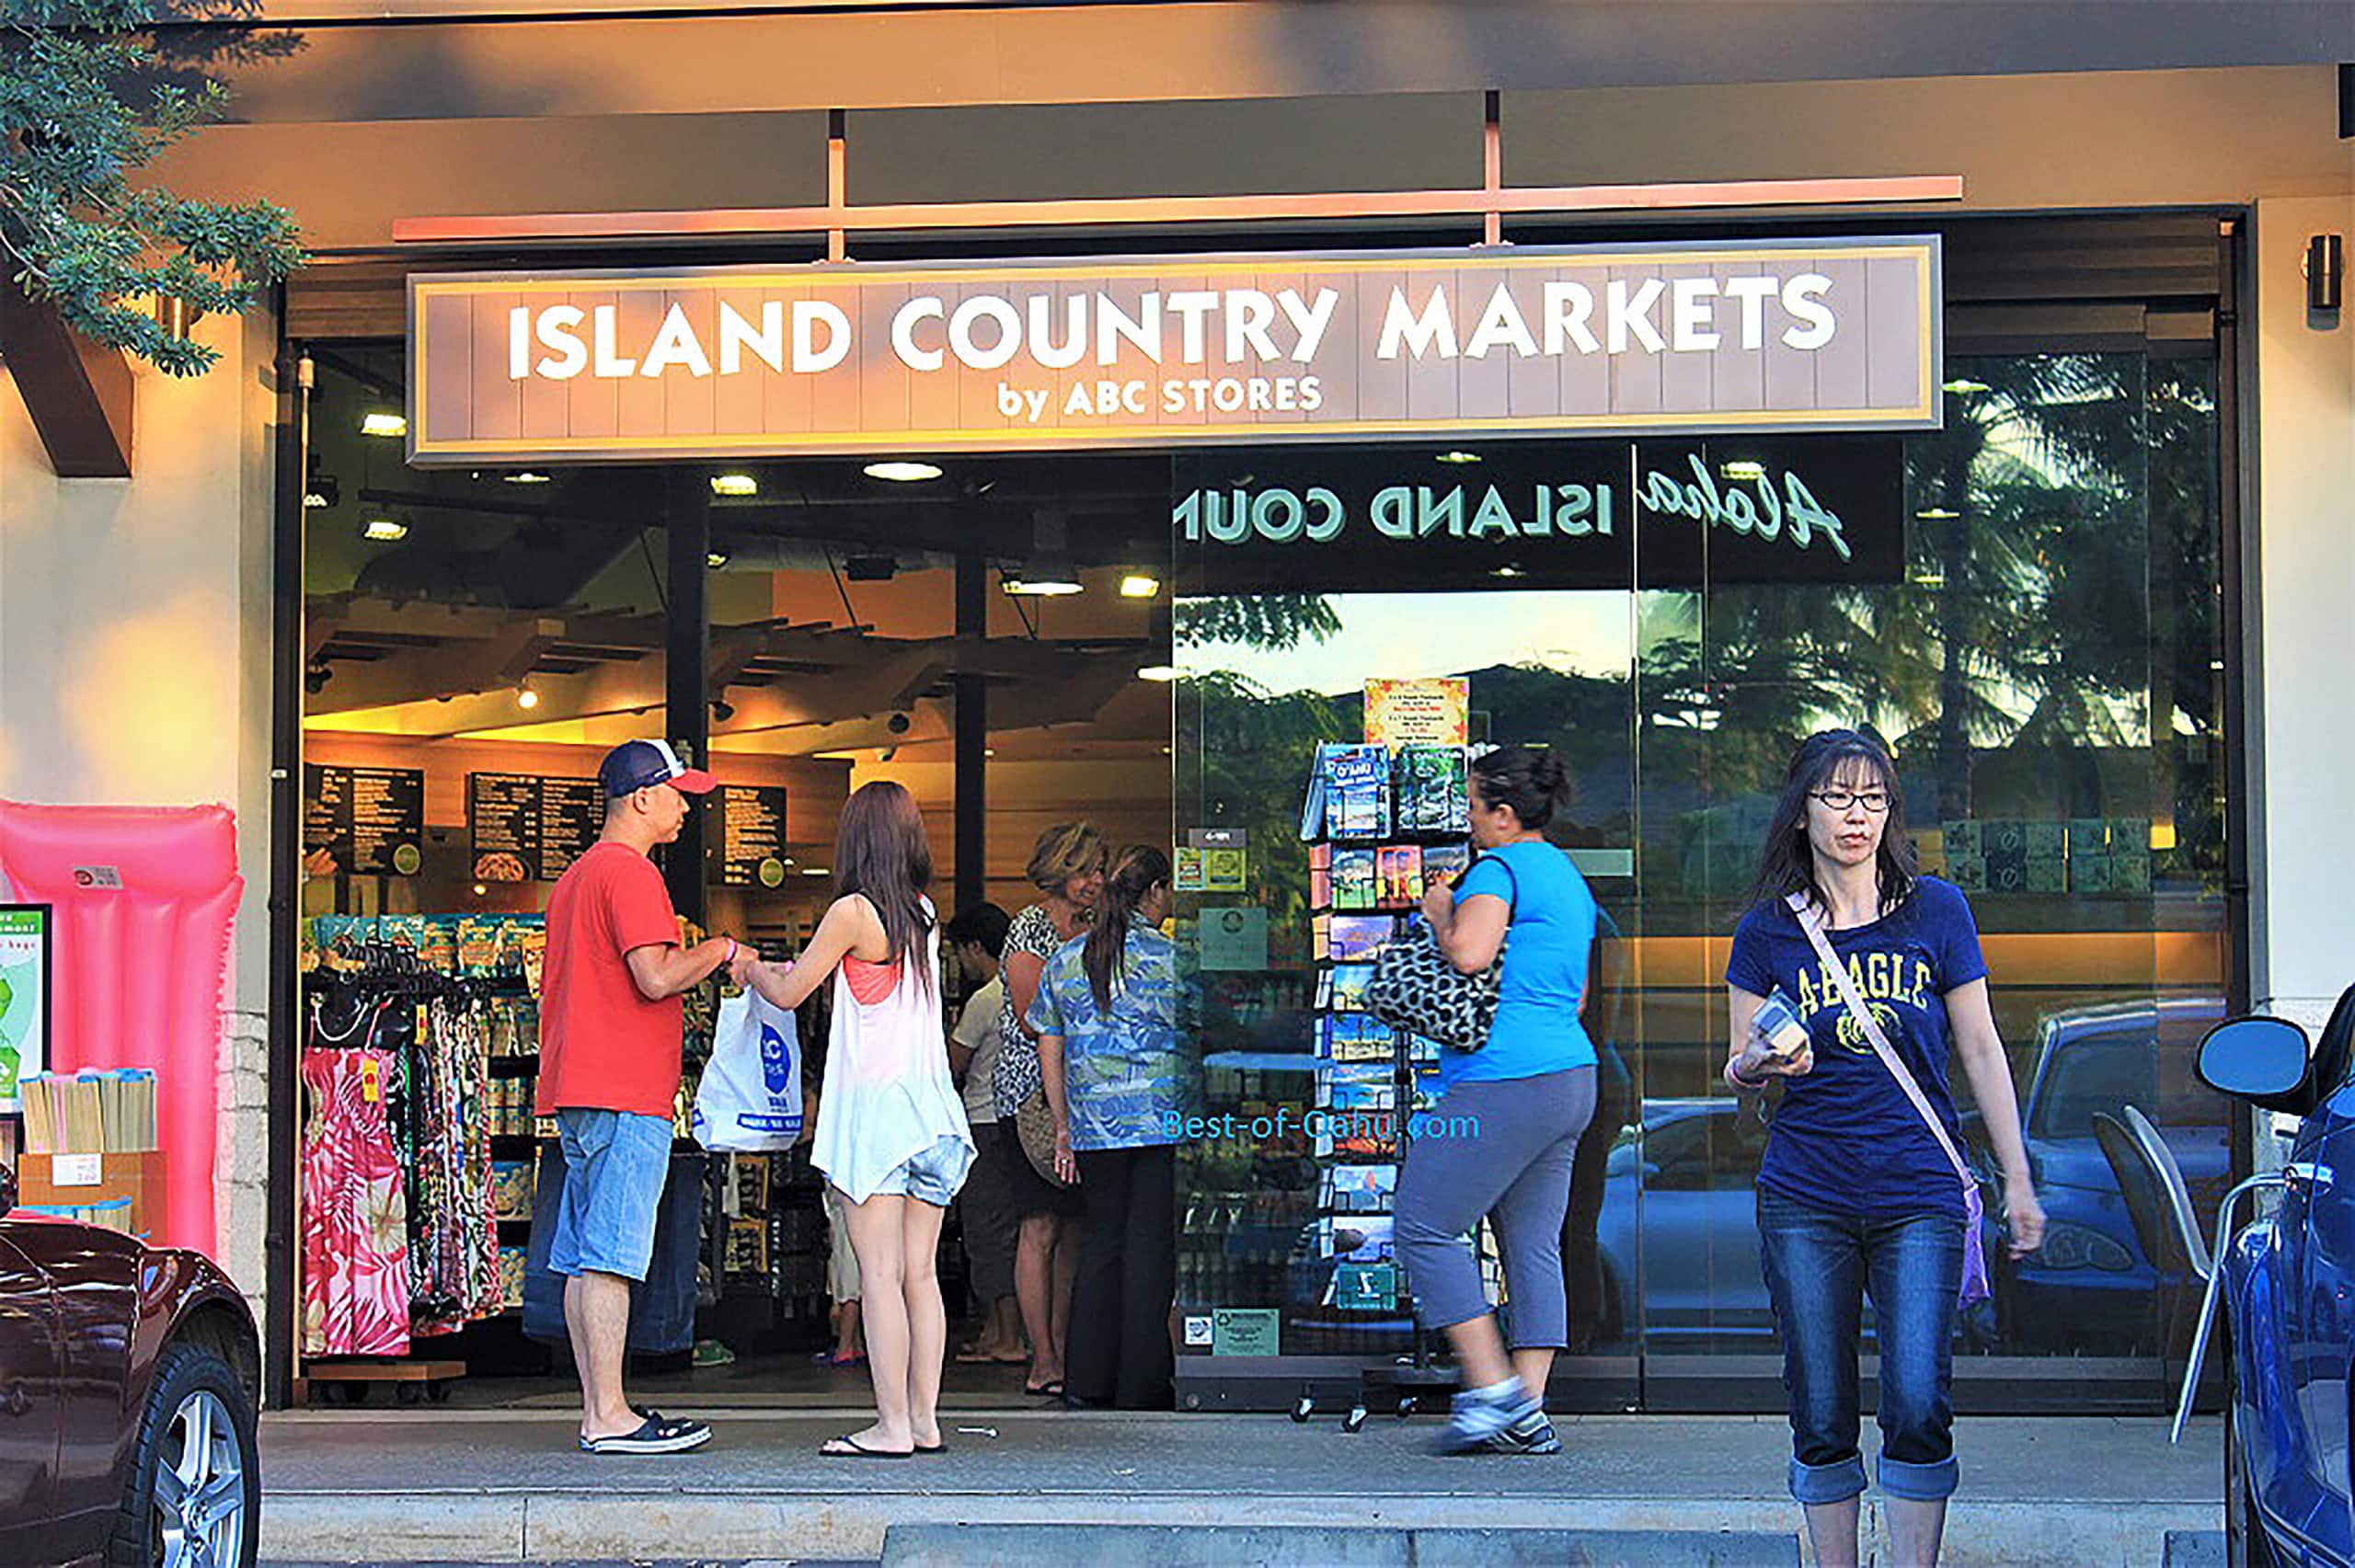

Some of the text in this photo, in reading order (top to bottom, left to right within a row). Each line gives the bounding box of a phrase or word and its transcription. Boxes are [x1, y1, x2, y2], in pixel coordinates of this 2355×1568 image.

[509, 273, 1836, 380] ISLAND COUNTRY MARKETS
[997, 375, 1323, 423] by ABC STORES
